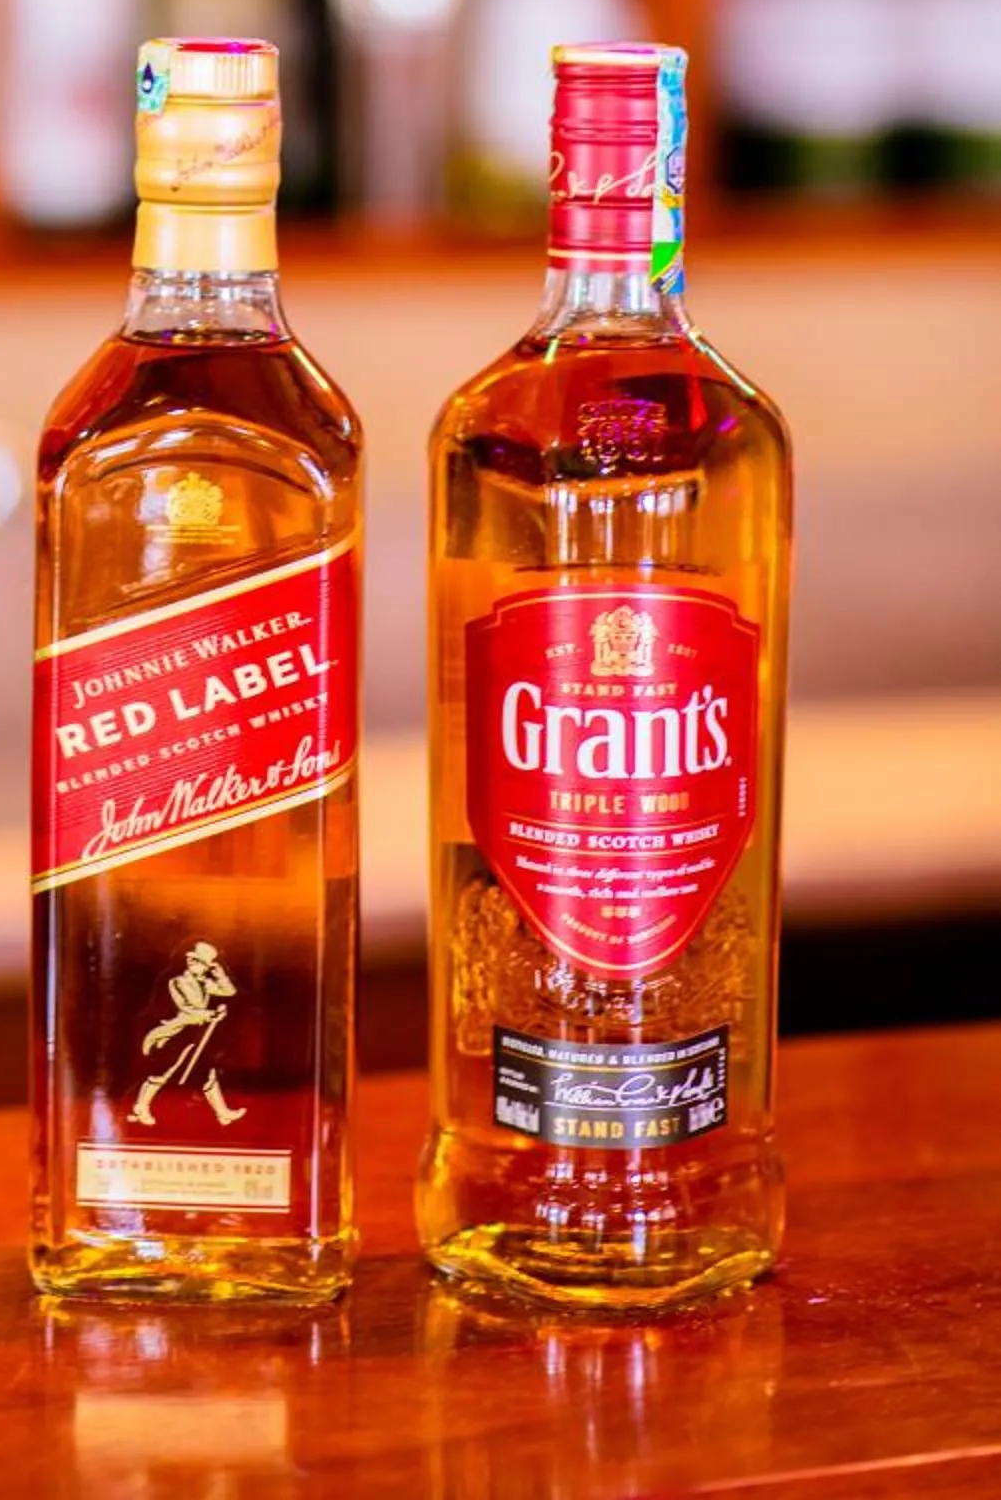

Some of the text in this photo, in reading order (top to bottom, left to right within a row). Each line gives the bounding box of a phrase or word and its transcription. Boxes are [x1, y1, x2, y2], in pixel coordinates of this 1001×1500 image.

[55, 642, 331, 760] RED LABEL
[70, 610, 304, 709] JOHNNIE WALKER
[55, 692, 329, 795] BLENDED SCOTCH WHISKY
[501, 680, 730, 781] Grant's
[80, 795, 162, 864] John
[159, 763, 265, 826] Walker
[508, 820, 581, 849] BLENDED
[587, 833, 666, 850] SCOTCH
[549, 789, 626, 815] TRIPLE
[552, 1116, 625, 1140] STAND
[632, 1115, 682, 1140] FAST
